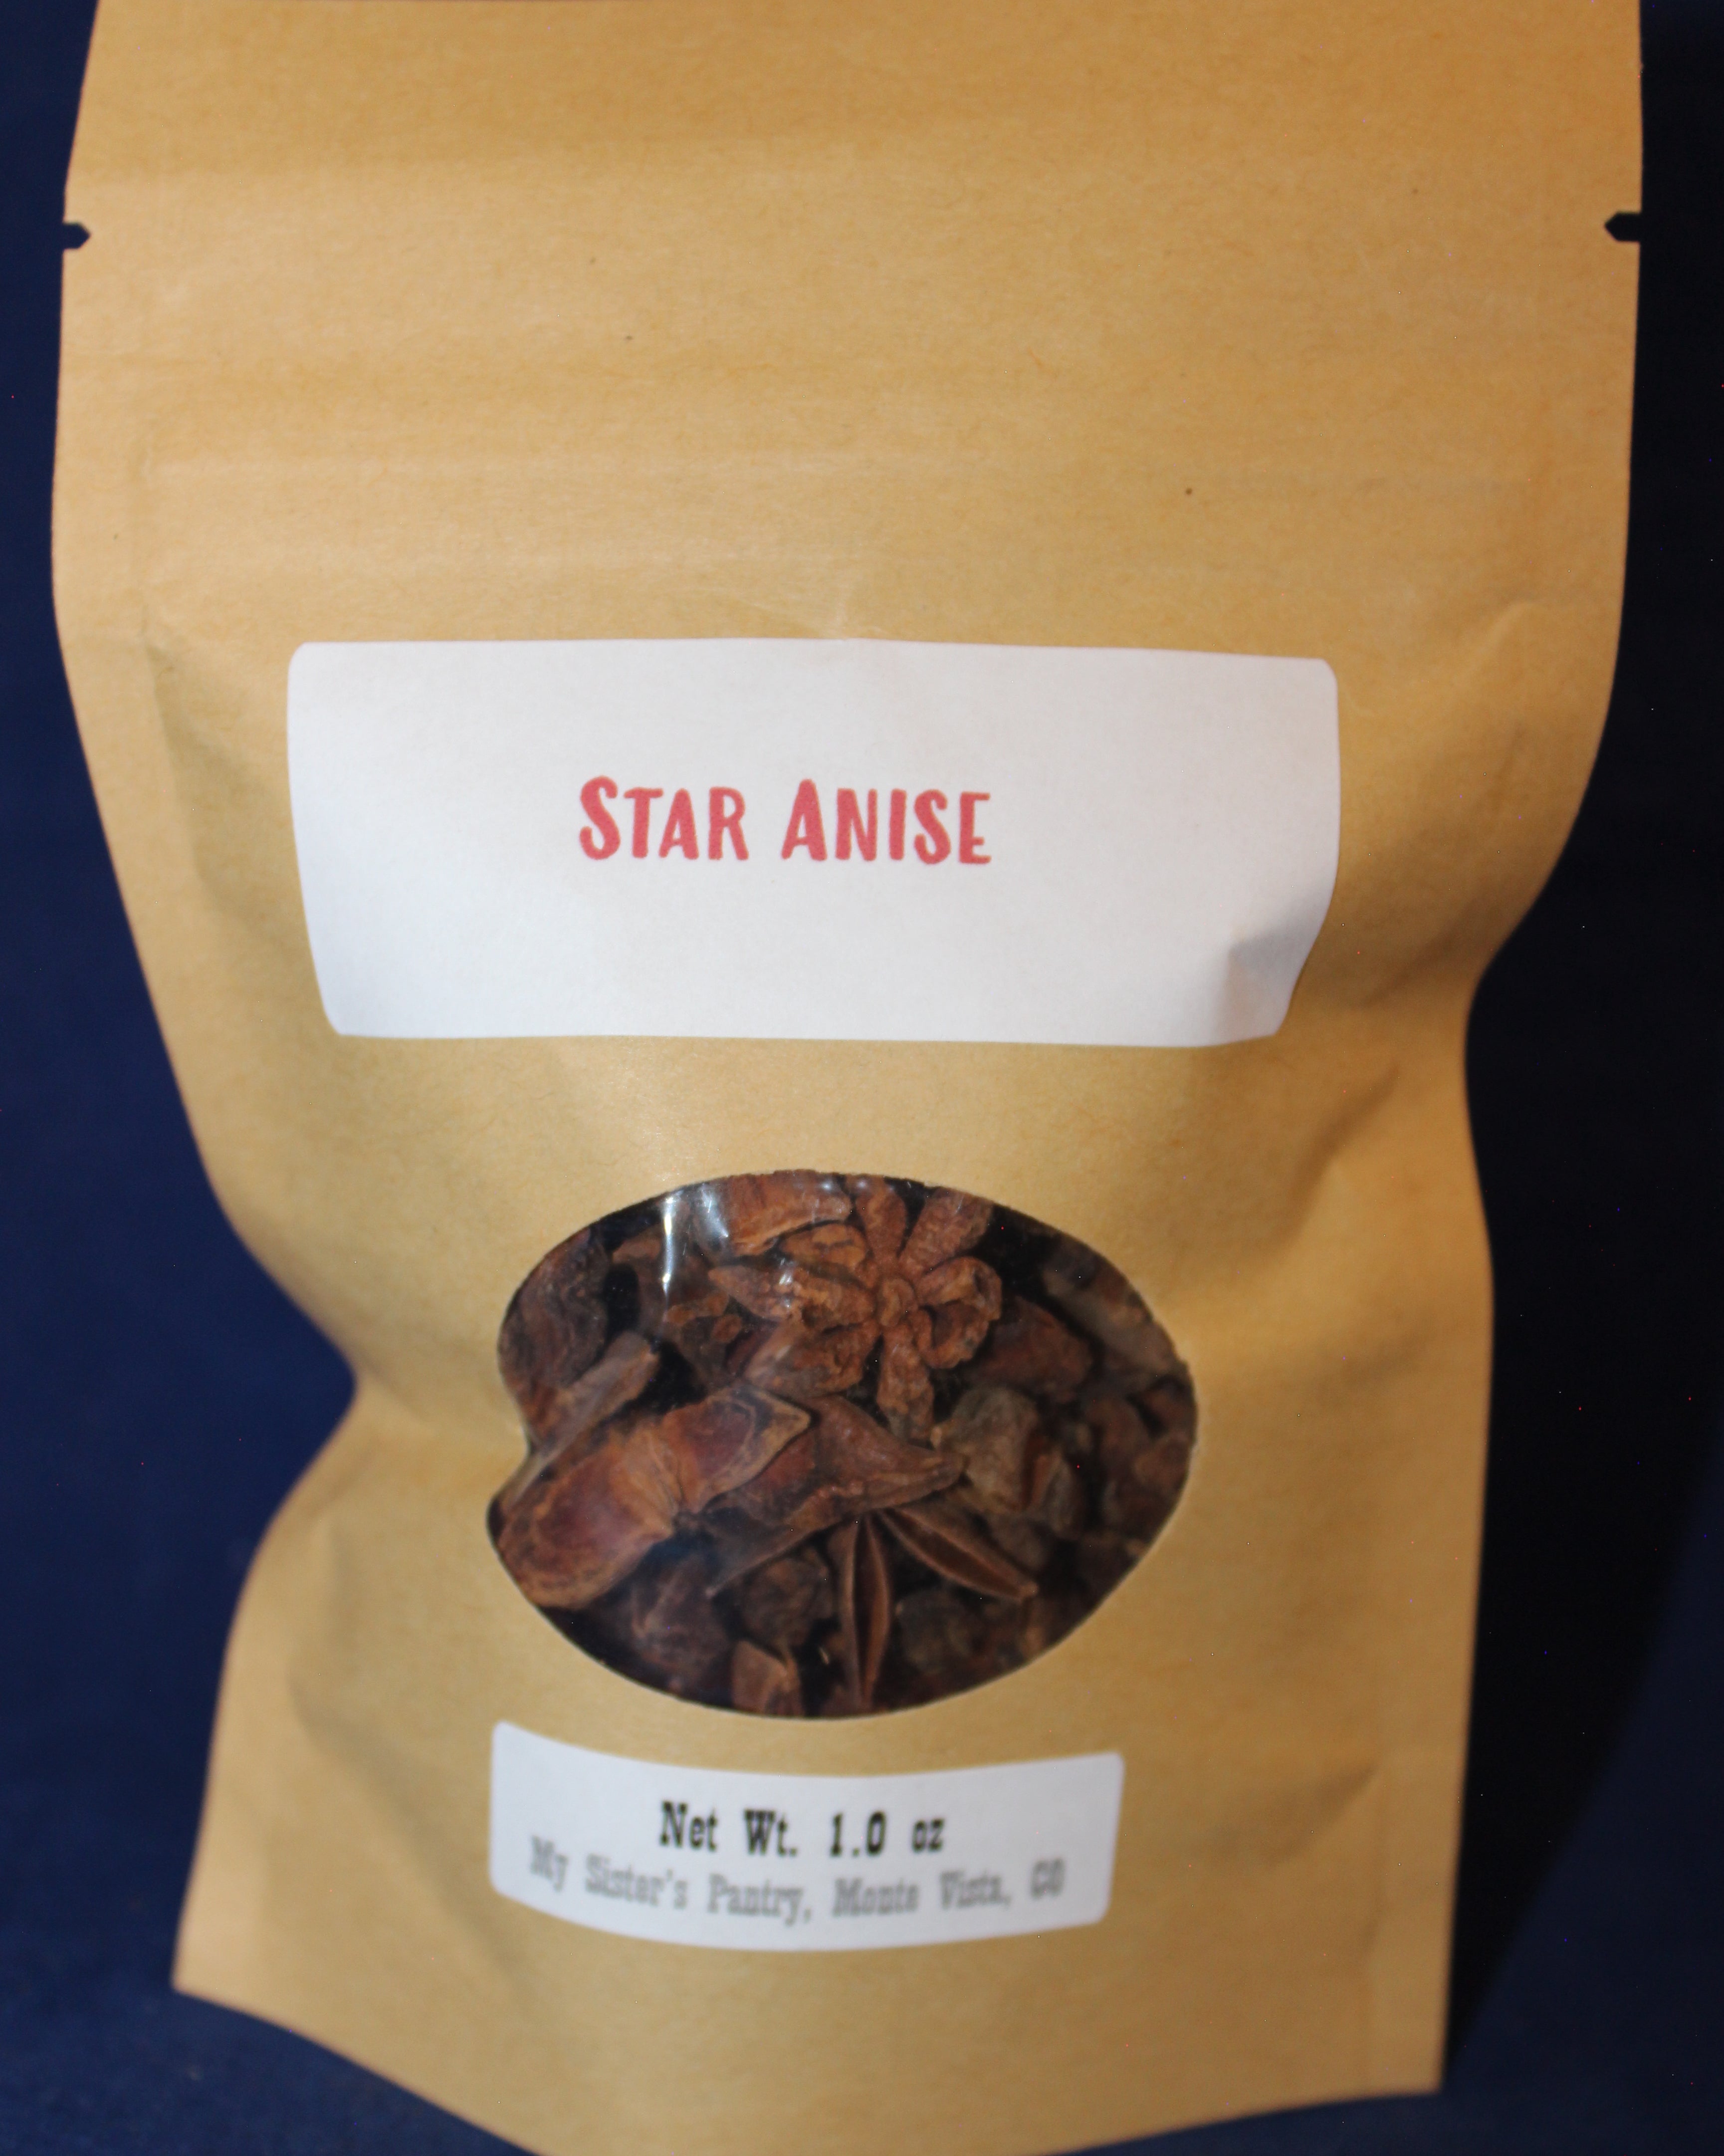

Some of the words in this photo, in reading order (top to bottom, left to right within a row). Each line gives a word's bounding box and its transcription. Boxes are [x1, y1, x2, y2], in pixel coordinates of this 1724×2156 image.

[579, 775, 749, 861] STAR
[781, 778, 992, 865] ANISE
[659, 1800, 718, 1852] Net
[743, 1809, 798, 1857] Wt.
[829, 1811, 886, 1857] 1.0
[912, 1818, 944, 1852] oz
[530, 1834, 568, 1892] My
[585, 1853, 688, 1910] Sister's
[706, 1872, 812, 1927] Pantry,
